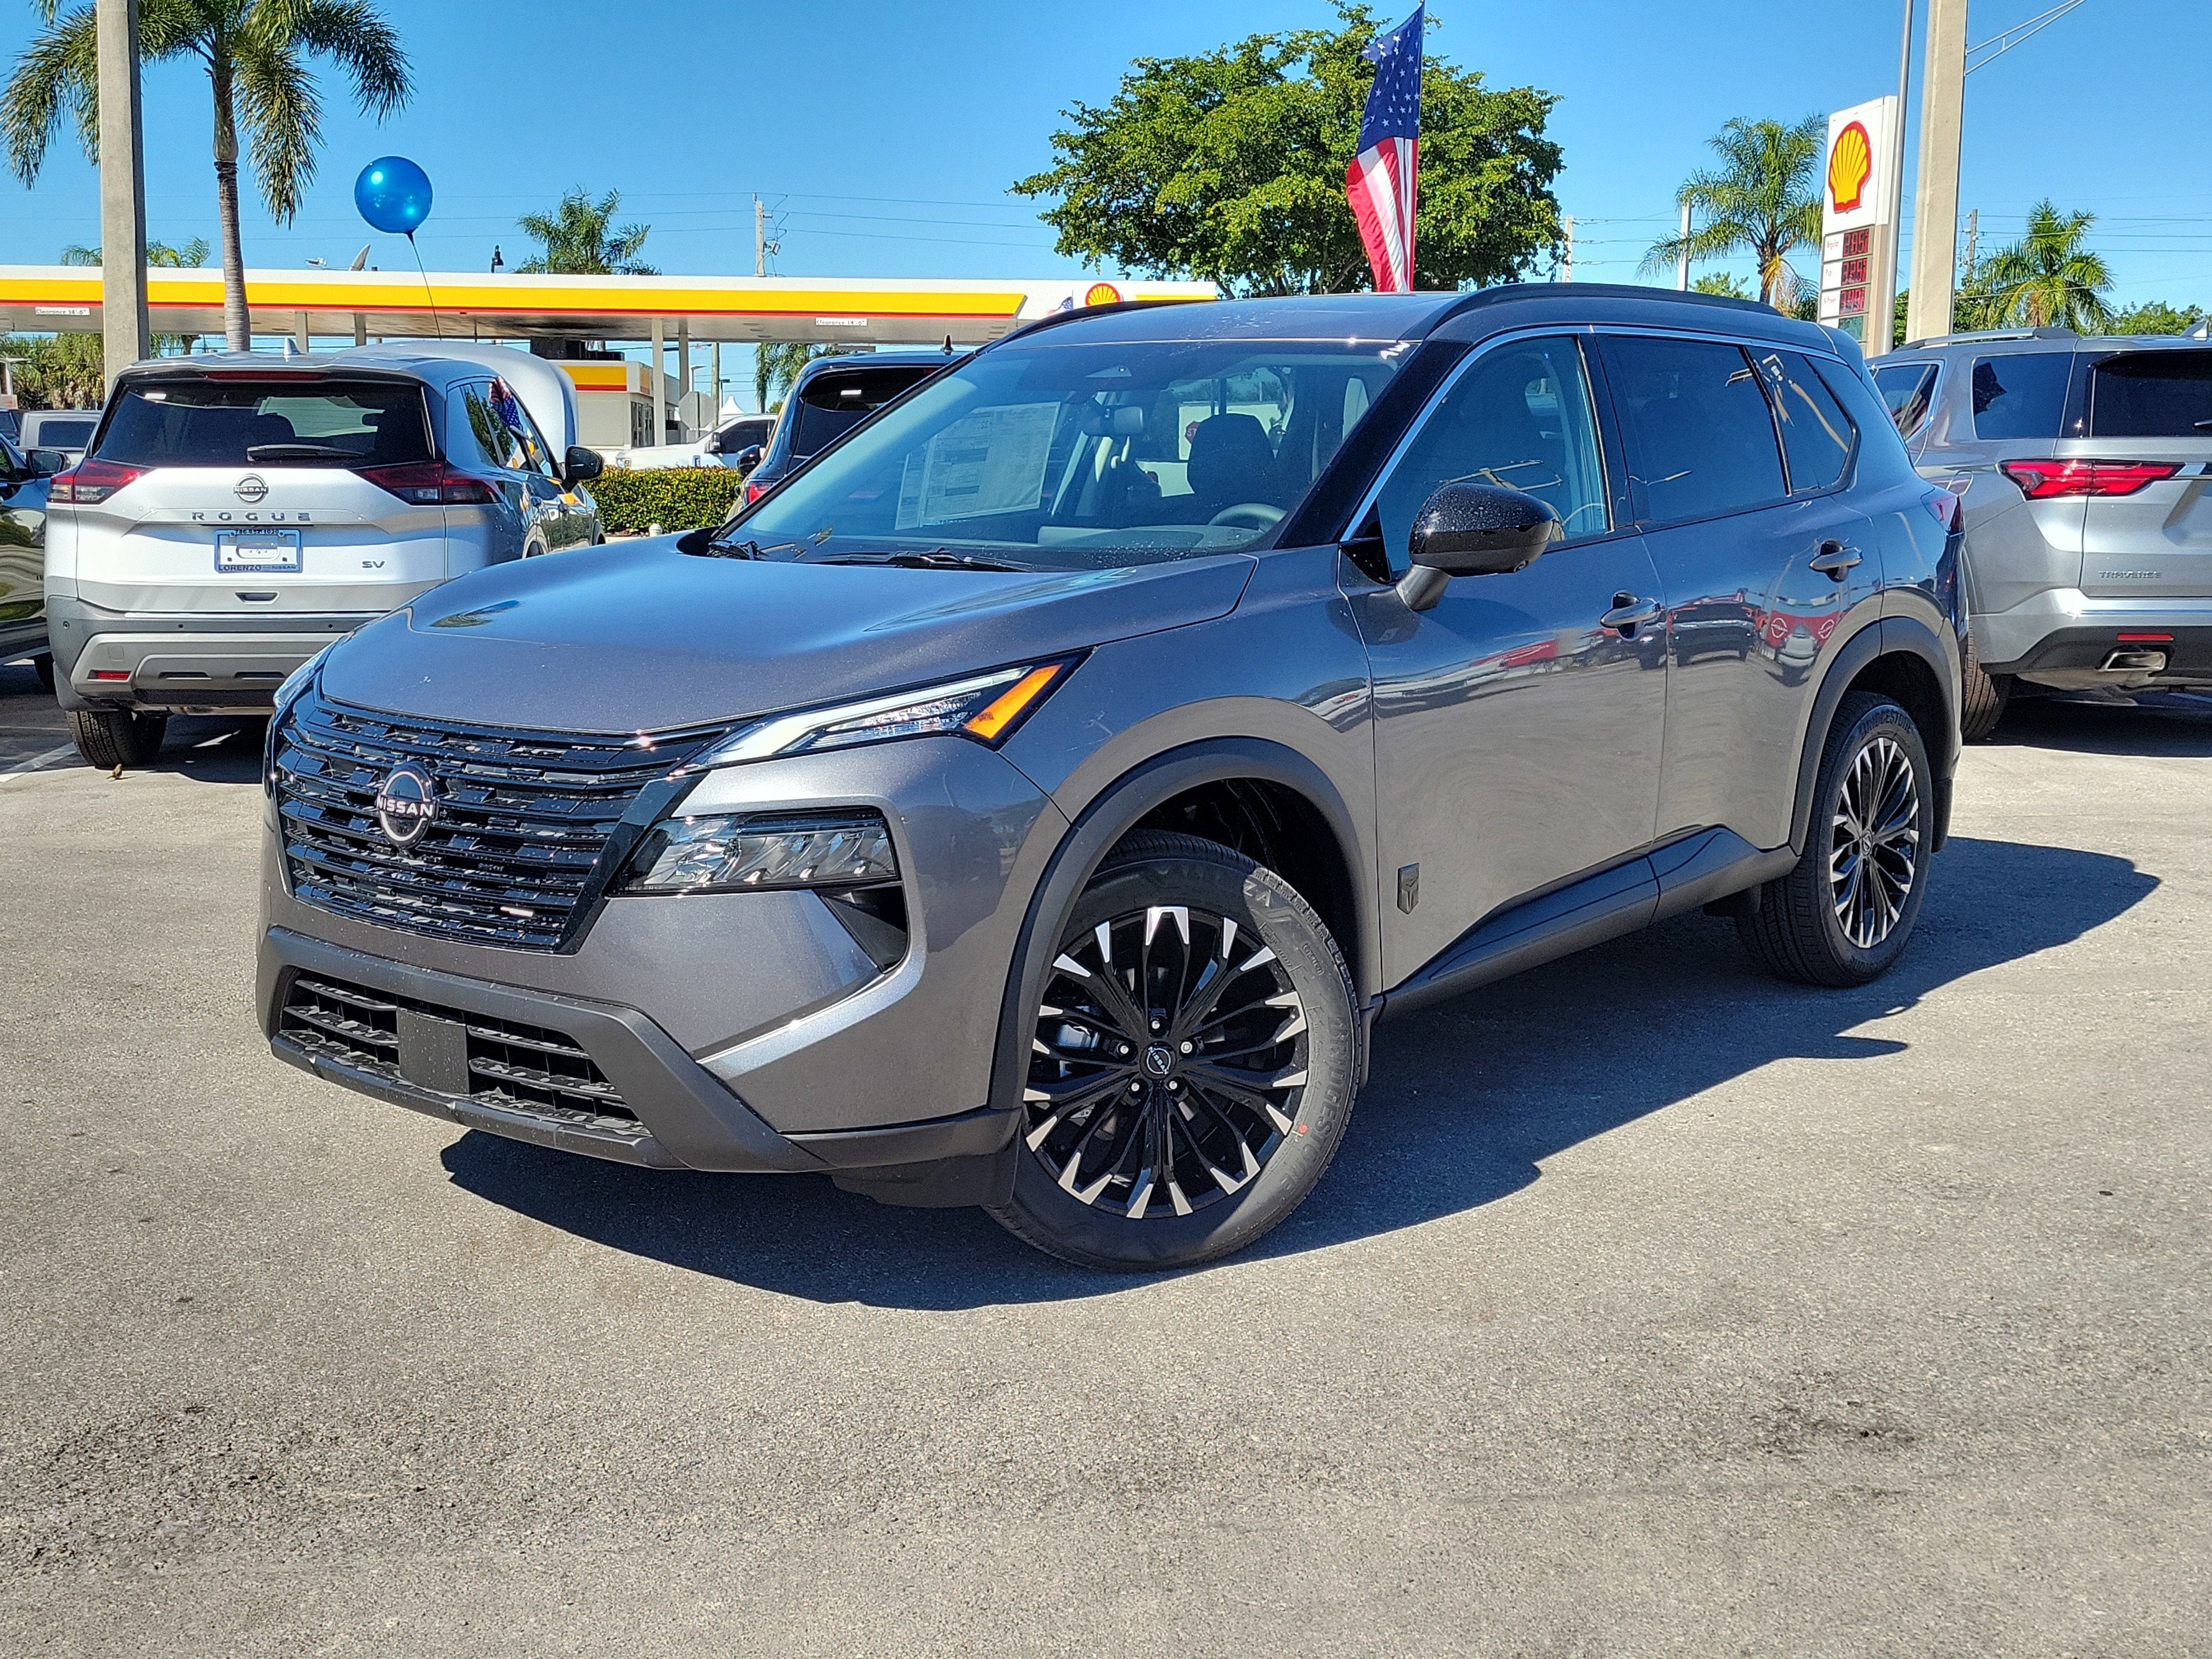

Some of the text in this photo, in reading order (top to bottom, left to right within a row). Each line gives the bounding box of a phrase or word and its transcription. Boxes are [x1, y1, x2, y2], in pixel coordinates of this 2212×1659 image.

[192, 512, 311, 521] ROGUE
[376, 795, 433, 817] NISSAN
[1148, 1046, 1169, 1075] NISSAN
[1279, 1015, 1350, 1195] BRIDGESTONE
